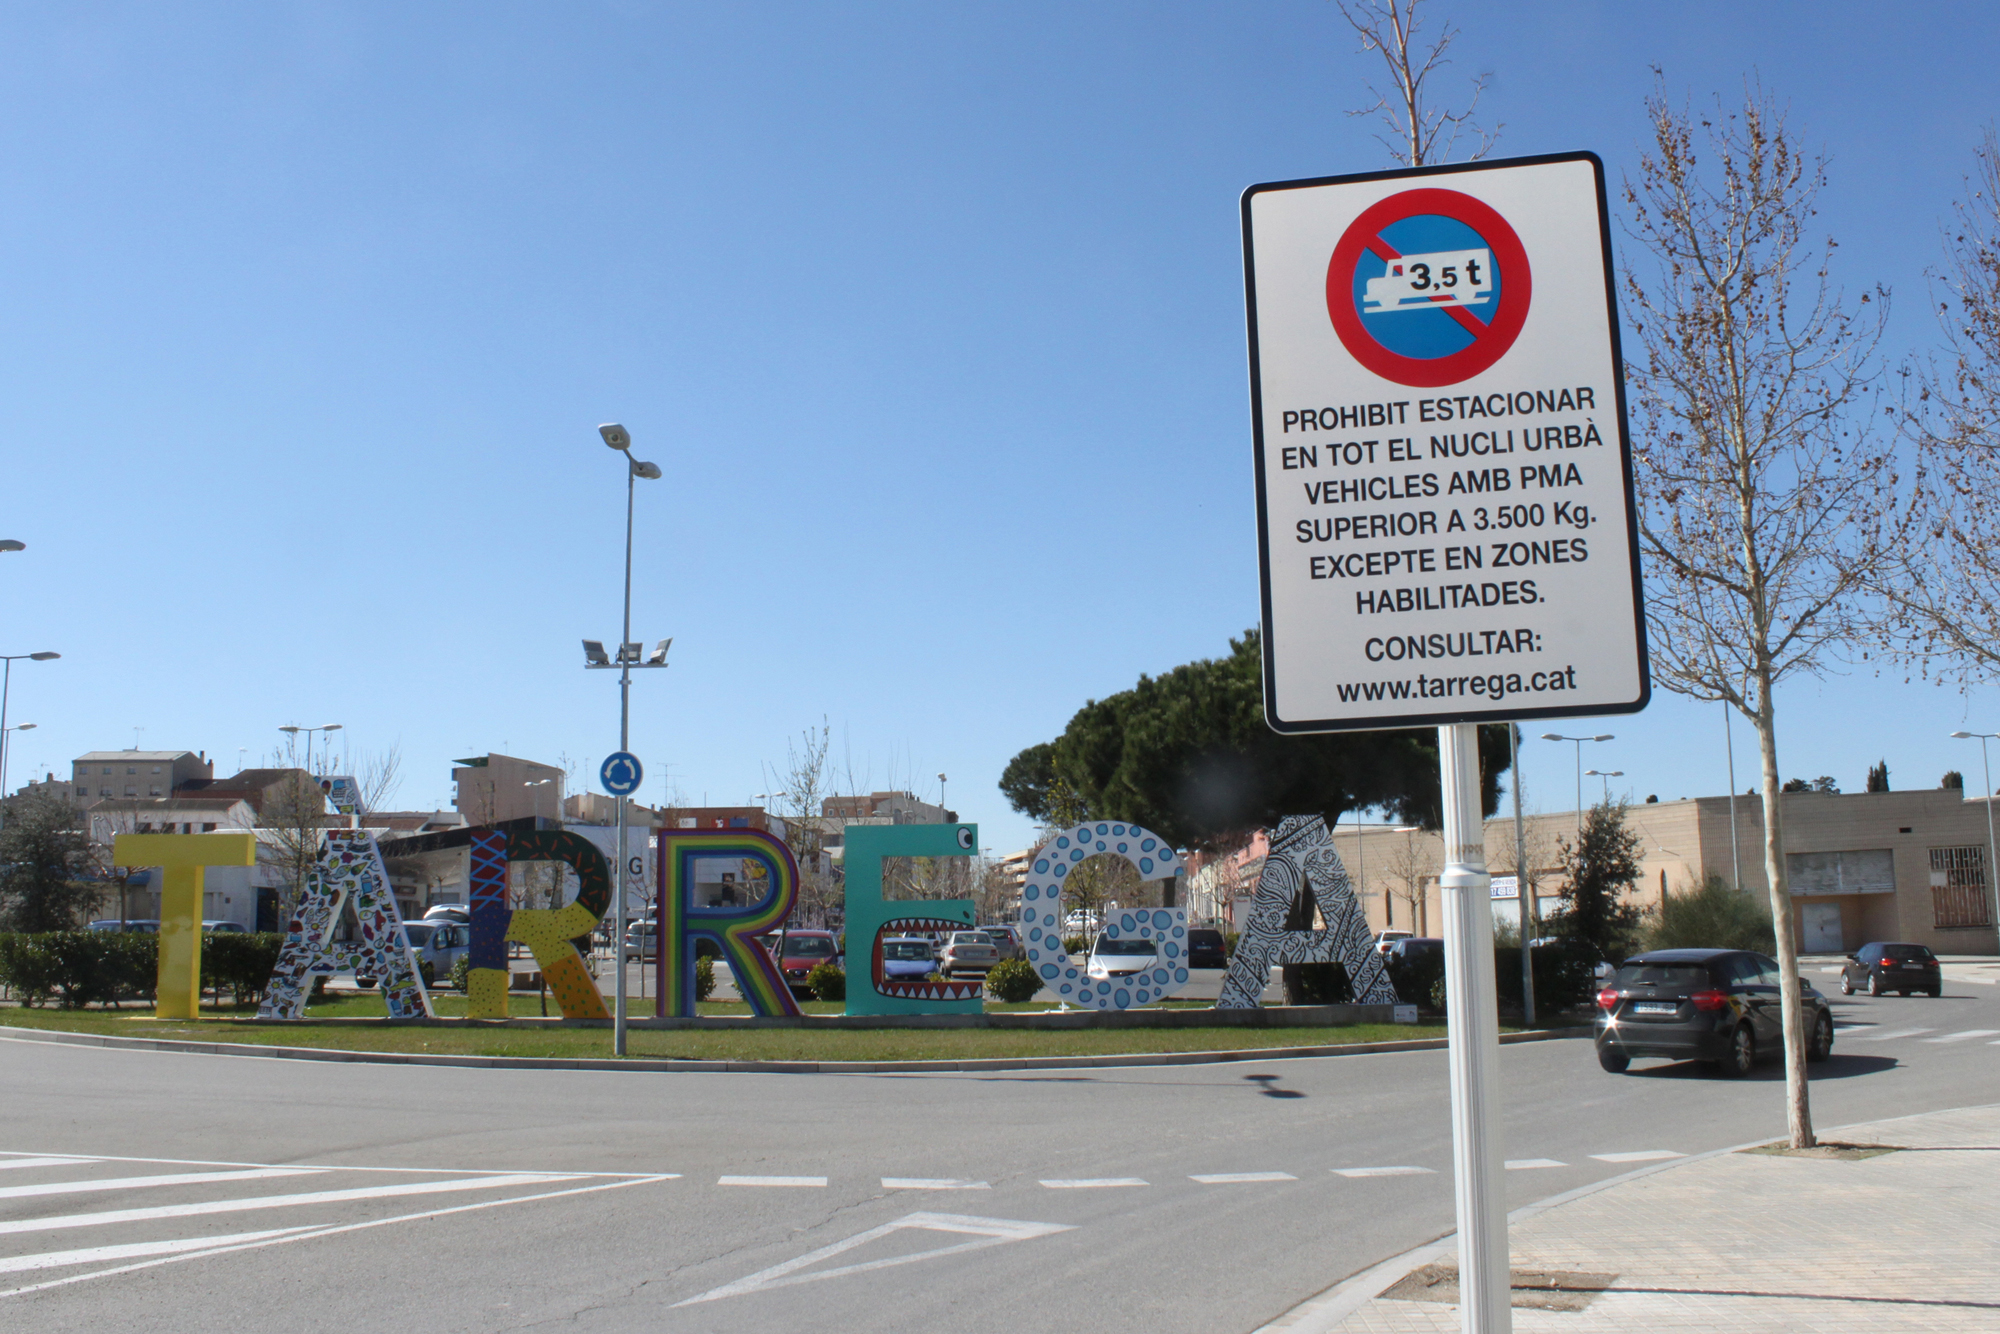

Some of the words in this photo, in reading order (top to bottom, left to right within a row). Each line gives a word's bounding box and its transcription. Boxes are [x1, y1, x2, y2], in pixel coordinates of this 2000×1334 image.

[1465, 259, 1482, 286] t
[1282, 401, 1410, 434] PROHIBIT
[1418, 386, 1596, 423] ESTACIONAR
[1281, 445, 1318, 470] EN
[1325, 440, 1379, 467] TOT
[1388, 437, 1422, 462] EL
[1430, 429, 1514, 460] NUCLI
[1523, 420, 1603, 452] URBÀ
[1303, 472, 1440, 505] VEHICLES
[1447, 467, 1511, 495] AMB
[1520, 461, 1584, 490] PMA
[1296, 510, 1438, 544] SUPERIOR
[1446, 508, 1467, 533] A
[1473, 503, 1545, 533] 3.500
[1553, 500, 1597, 530] Kg.
[1310, 548, 1436, 580] EXCEPTE
[1444, 545, 1483, 571] EN
[1491, 537, 1589, 568] ZONES
[1356, 579, 1545, 615] HABILITADES.
[1364, 628, 1542, 662] CONSULTAR:
[1336, 665, 1577, 704] www.tarrega.cat
